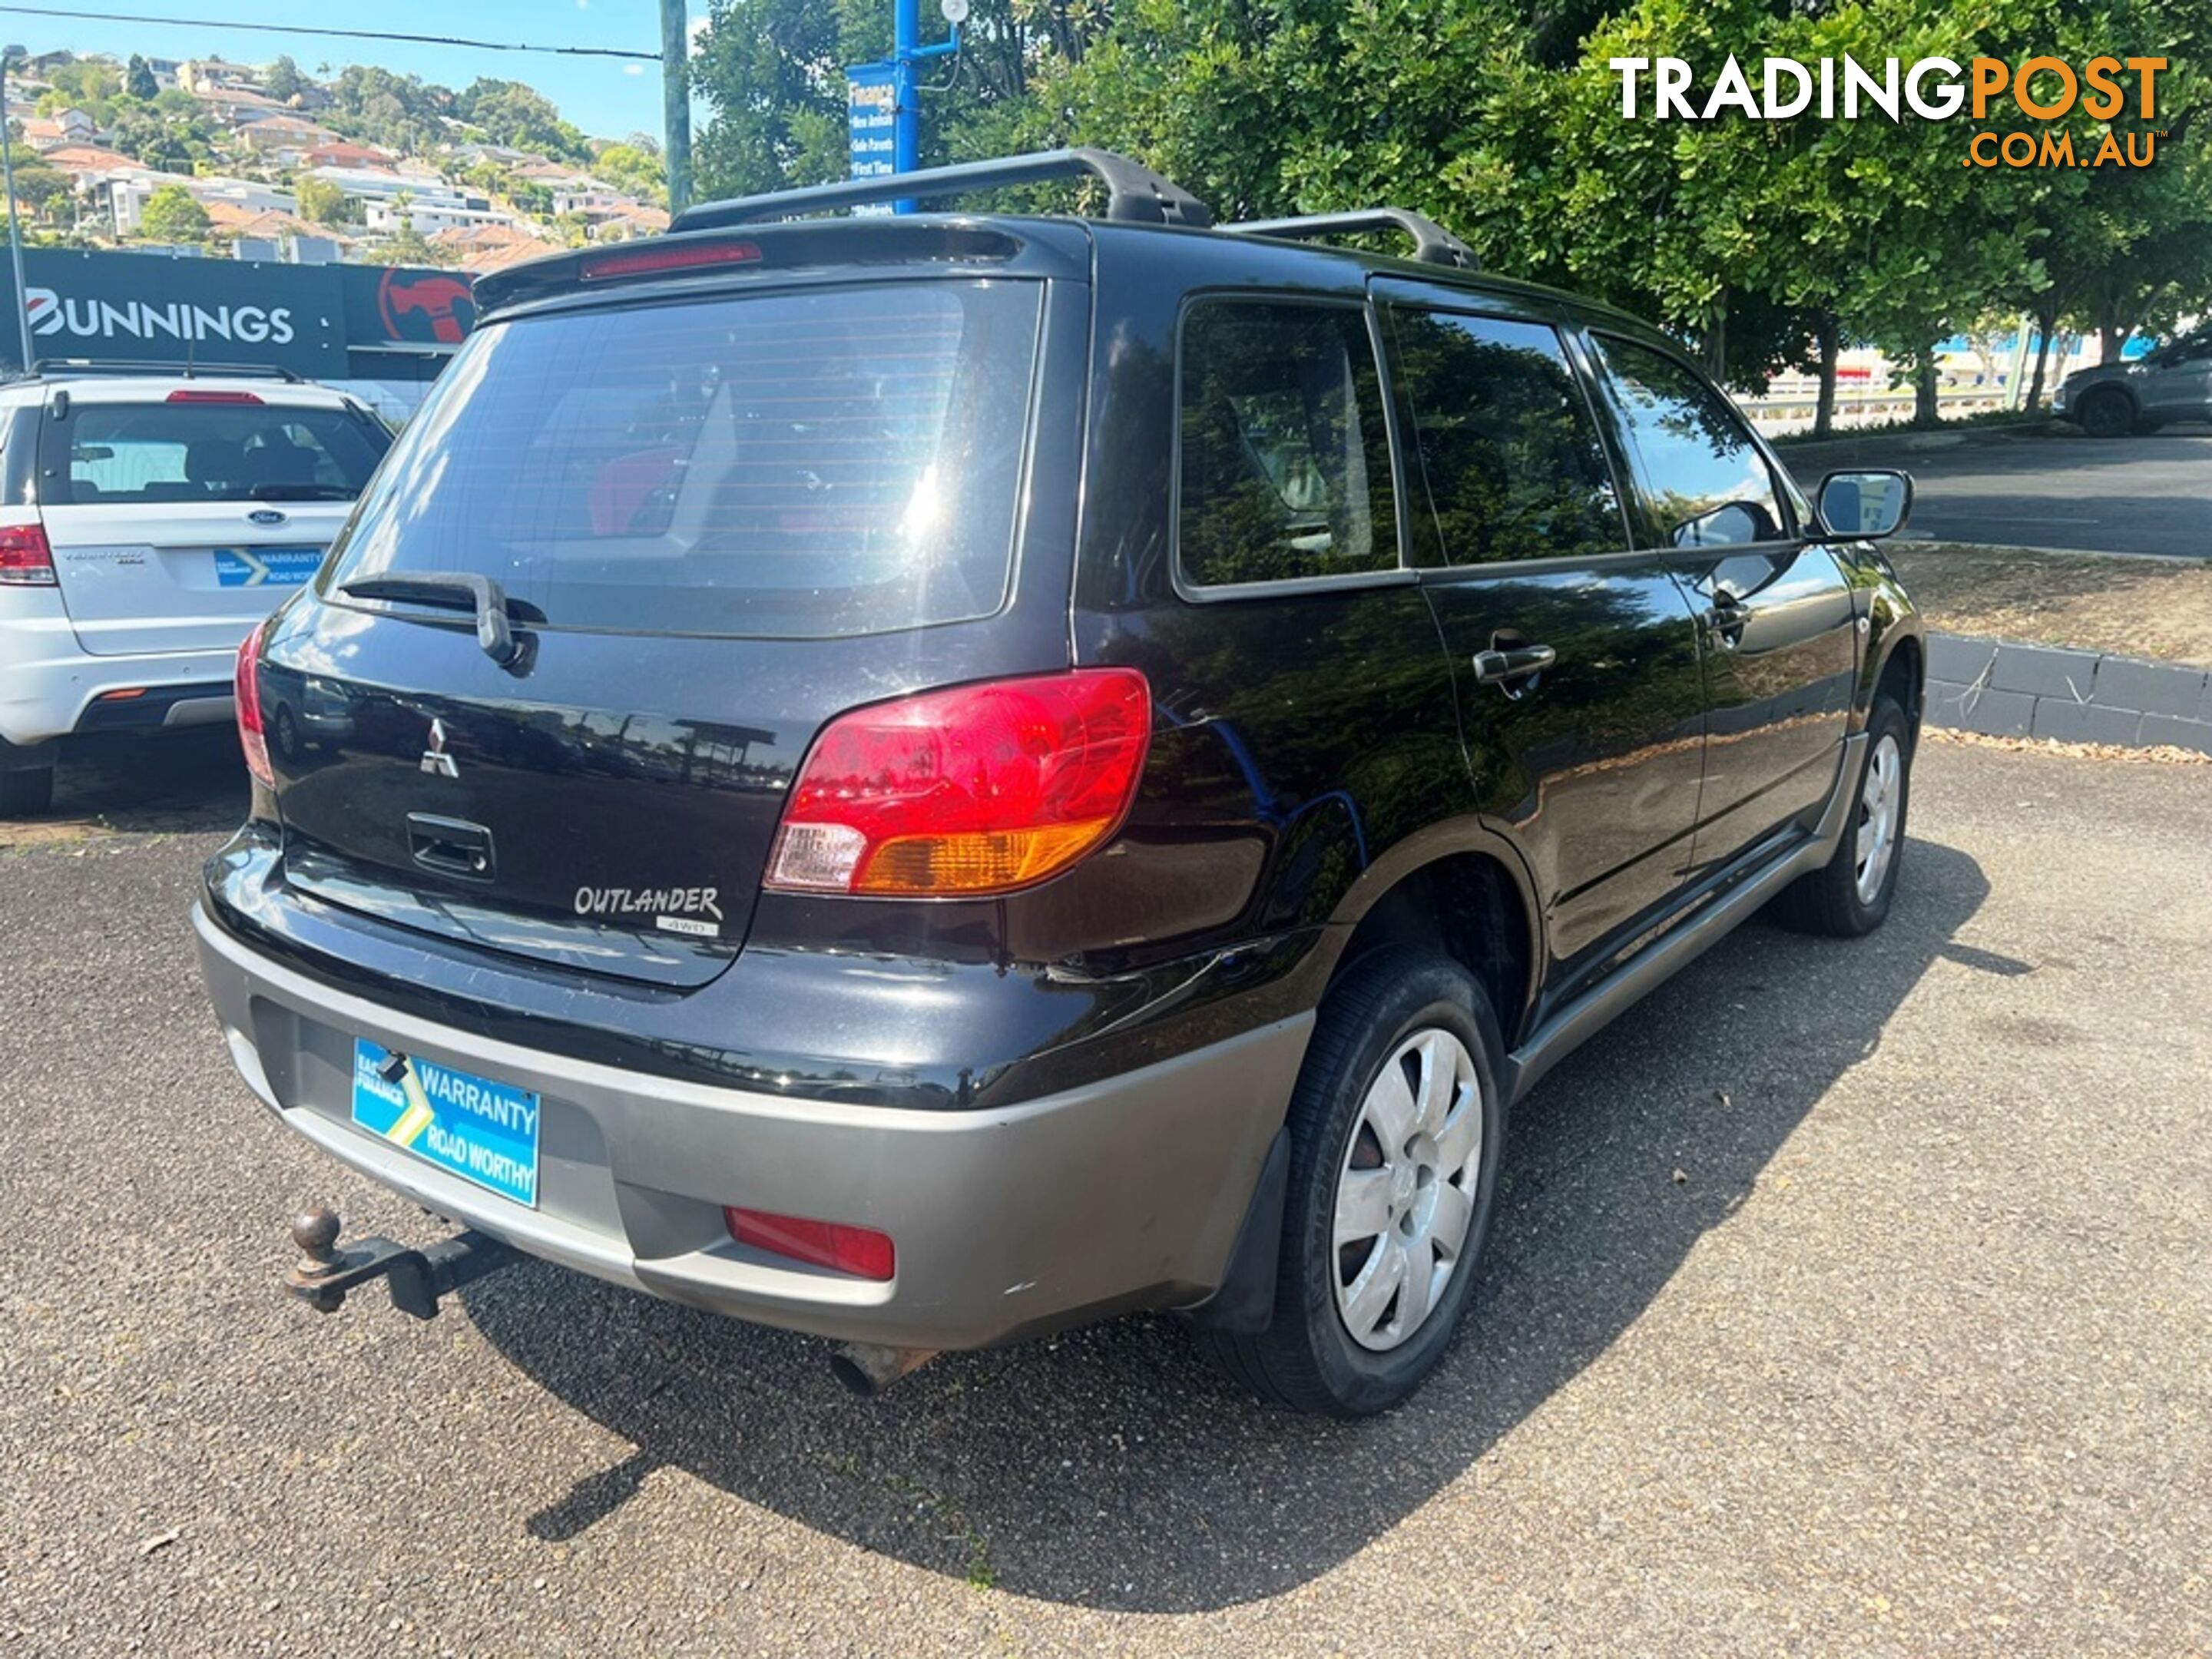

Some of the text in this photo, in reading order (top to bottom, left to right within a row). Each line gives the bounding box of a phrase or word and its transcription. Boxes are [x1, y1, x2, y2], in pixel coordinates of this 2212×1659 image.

[25, 286, 294, 344] BUNNINGS
[575, 886, 724, 921] OUTLANDER
[421, 1064, 535, 1135] WARRANTY
[427, 1124, 534, 1193] ROAD WORTHY
